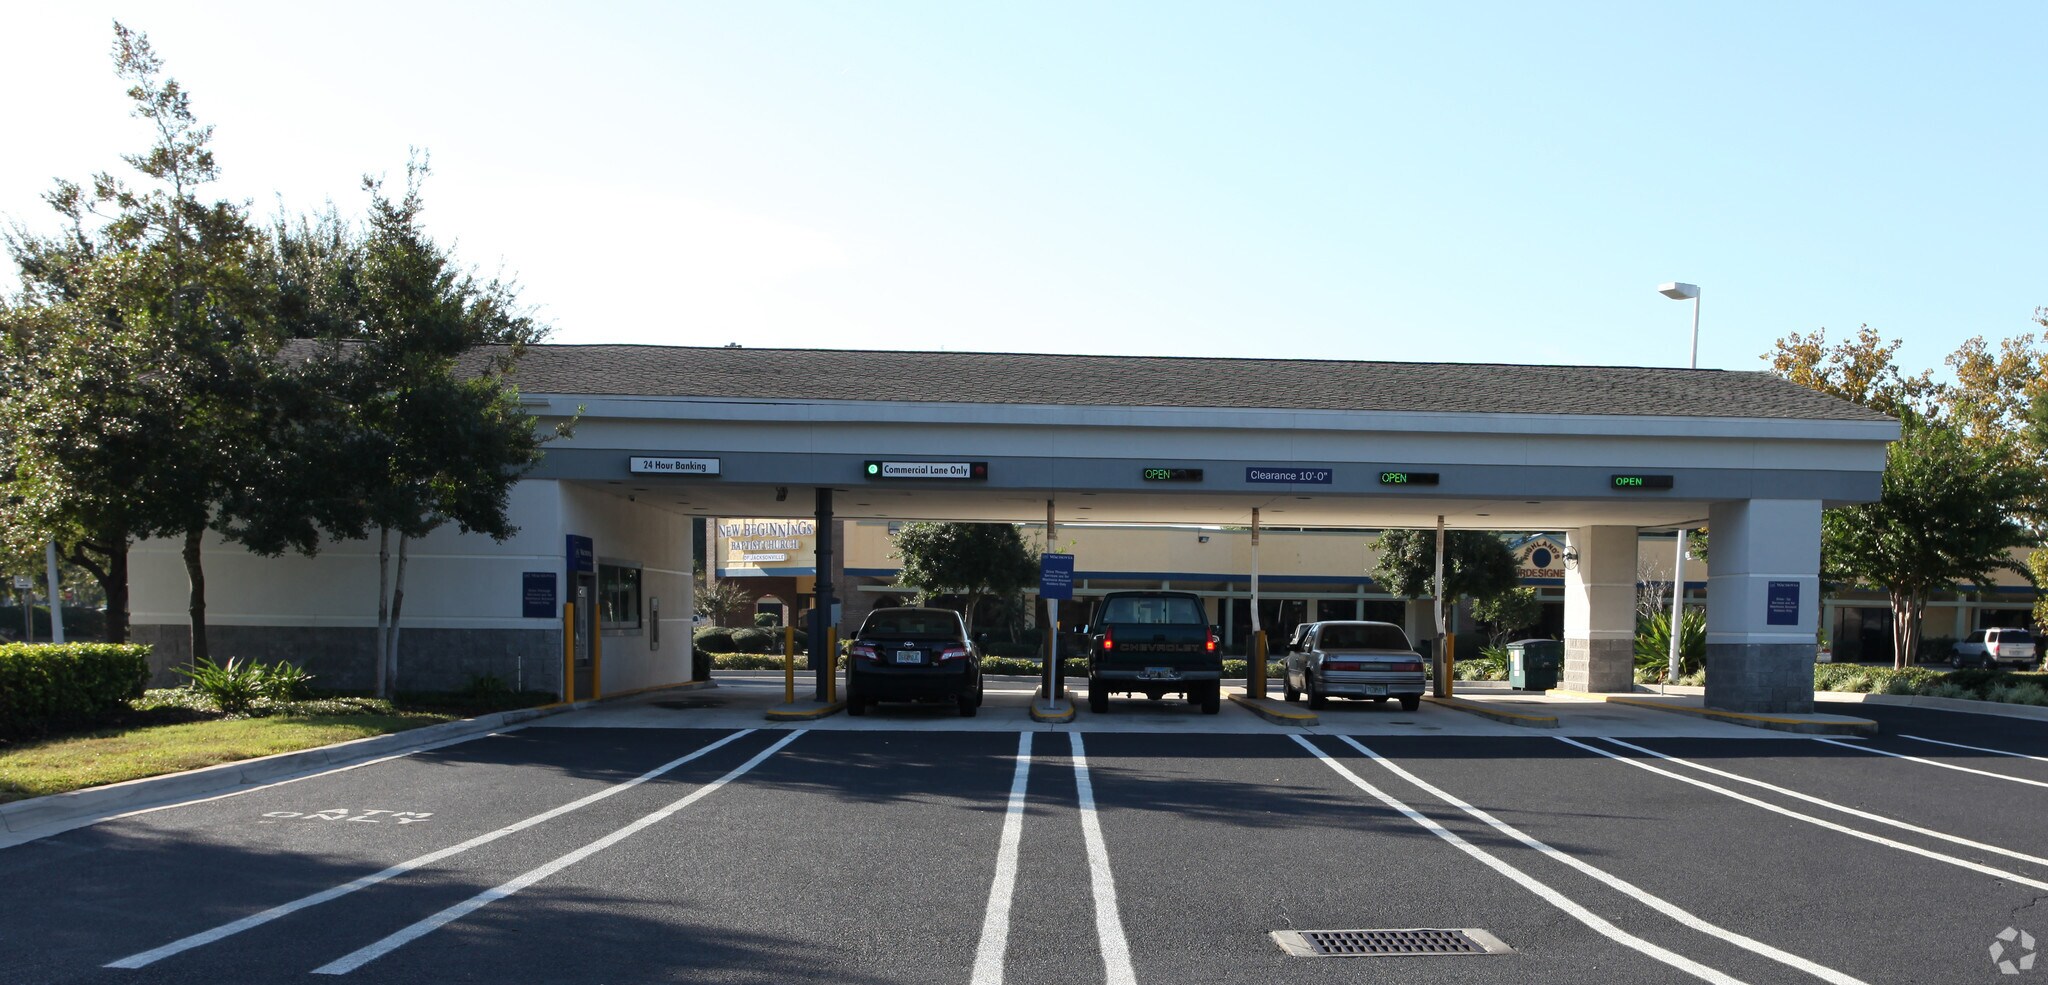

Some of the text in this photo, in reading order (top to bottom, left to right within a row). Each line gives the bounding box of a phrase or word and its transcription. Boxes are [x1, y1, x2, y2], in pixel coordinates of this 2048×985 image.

[643, 460, 707, 472] 24 Hour Banking
[884, 464, 968, 476] Commercial Lane Only
[1145, 469, 1171, 480] OPEN
[1250, 470, 1328, 481] Clearance 10'-0"
[1381, 472, 1407, 483] OPEN
[1615, 477, 1642, 486] OPEN
[718, 520, 814, 538] NEW BEGINNINGS
[731, 539, 799, 551] BAPTIST CHURCH
[1120, 643, 1200, 652] CHEVROLET
[260, 811, 432, 824] ONLY
[317, 808, 434, 819] ATM
